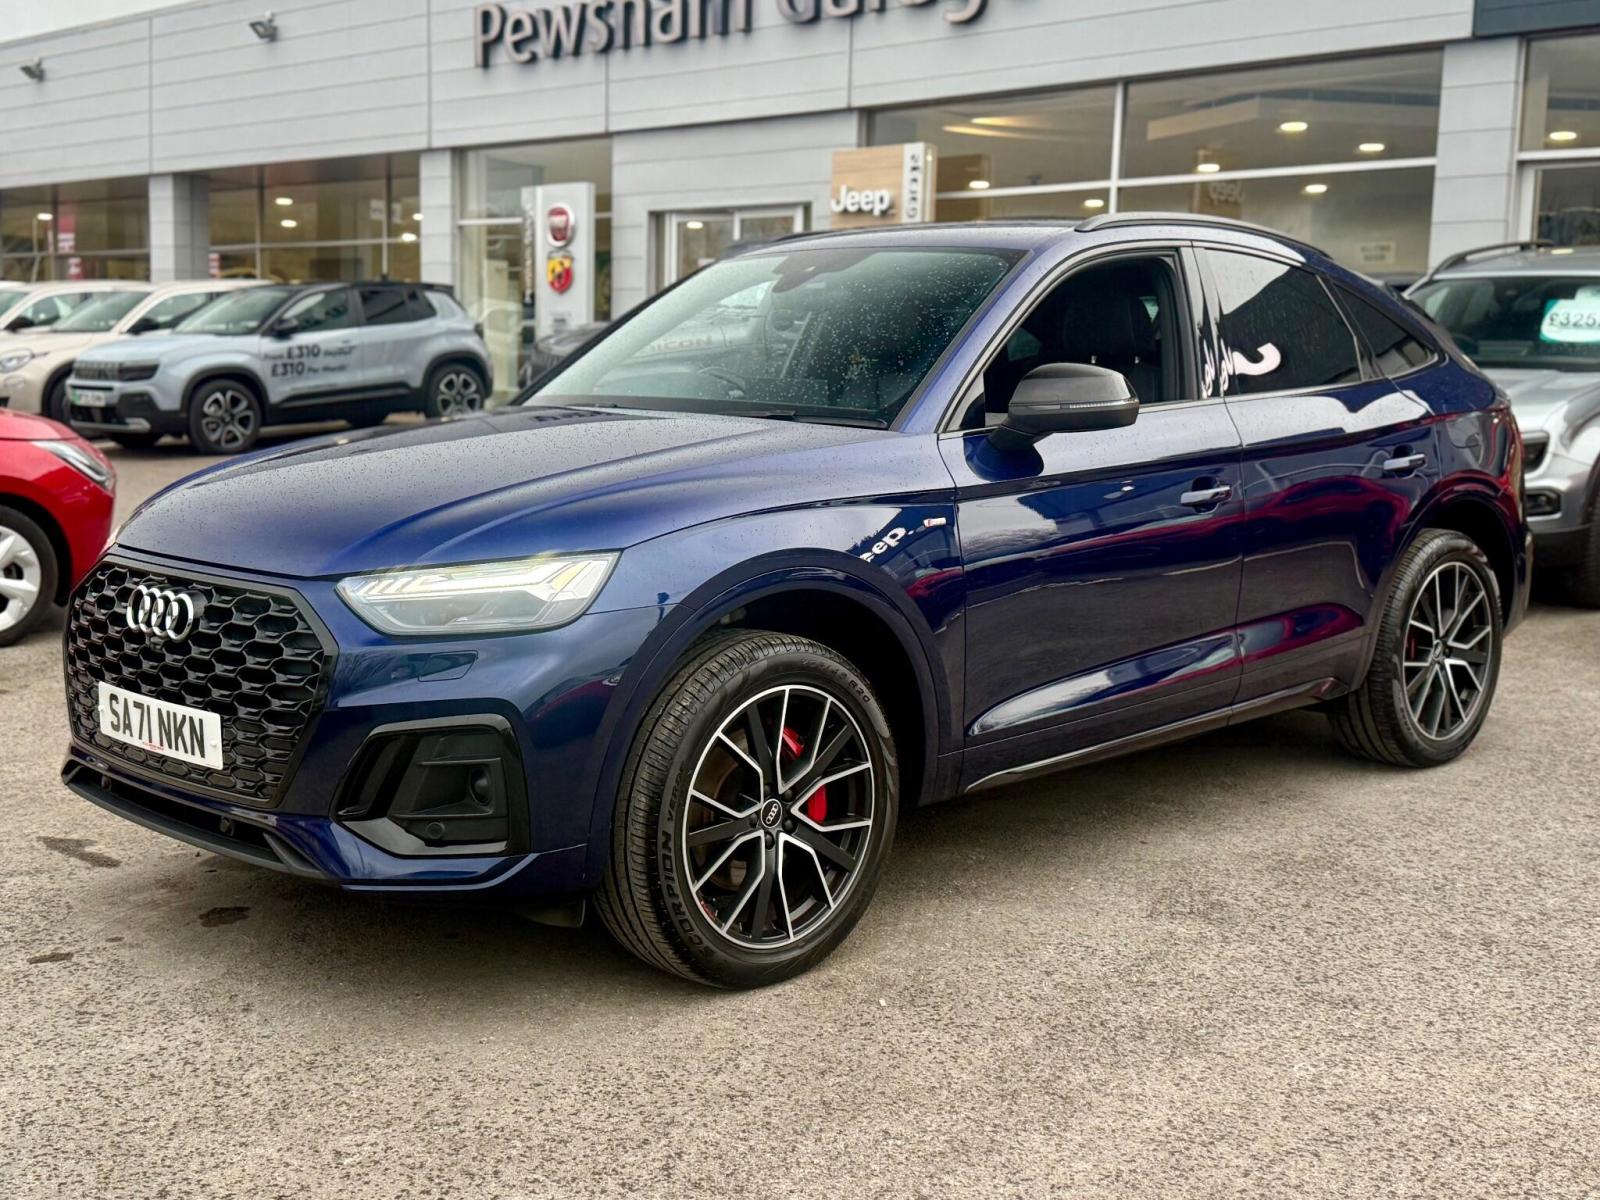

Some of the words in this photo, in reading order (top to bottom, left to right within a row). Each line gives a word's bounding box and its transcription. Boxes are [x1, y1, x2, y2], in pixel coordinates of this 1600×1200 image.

[831, 184, 890, 216] Jeep
[1549, 312, 1600, 327] £325
[287, 344, 321, 360] £310
[272, 362, 305, 377] £310
[109, 693, 152, 743] SA71
[158, 707, 206, 758] NKN
